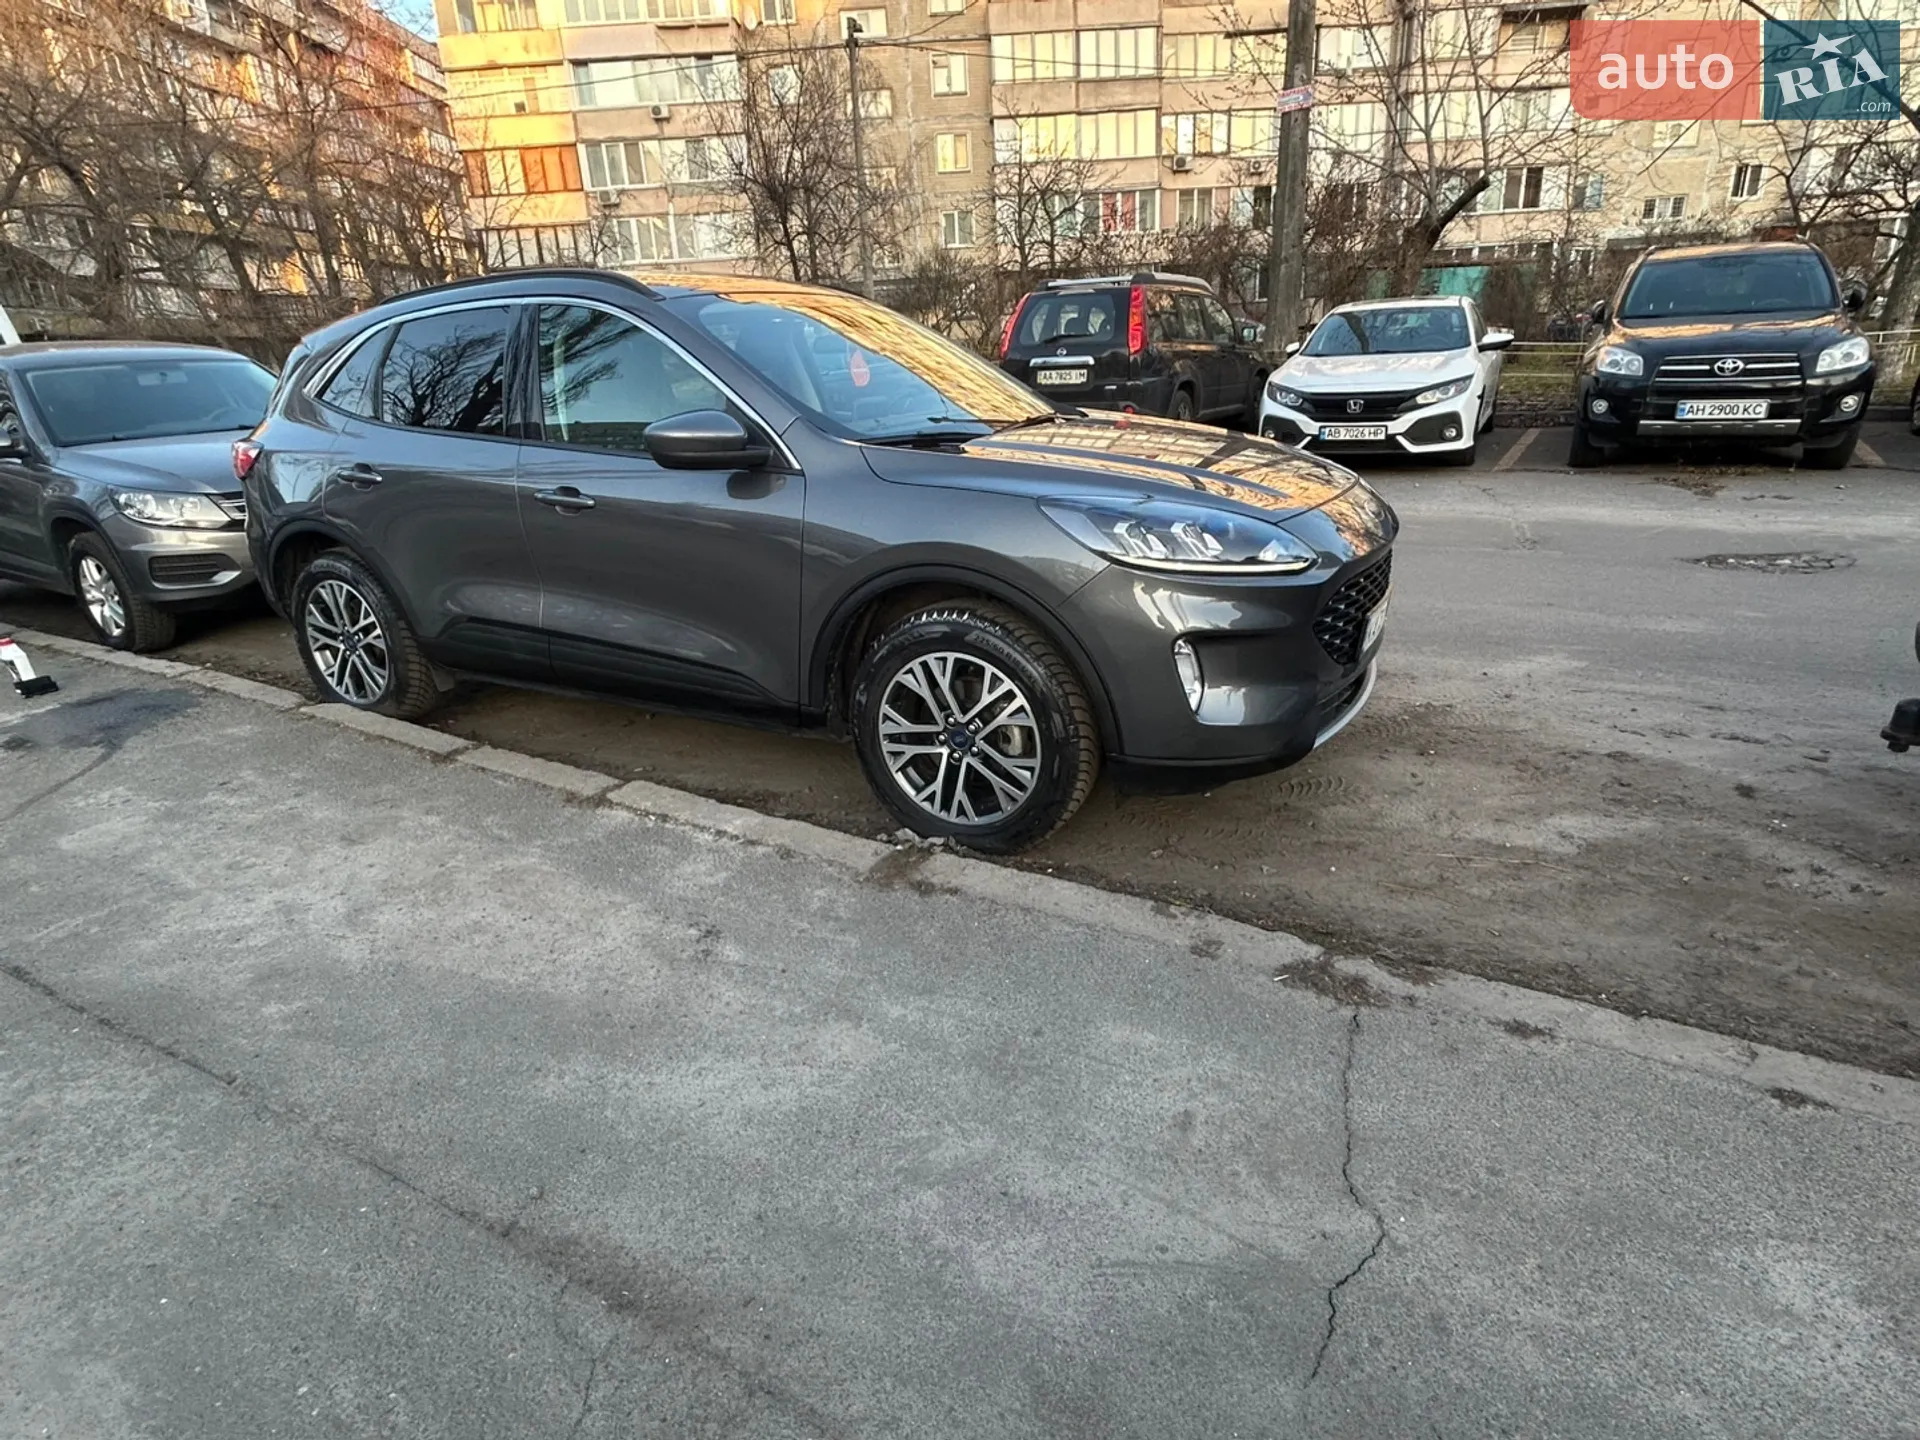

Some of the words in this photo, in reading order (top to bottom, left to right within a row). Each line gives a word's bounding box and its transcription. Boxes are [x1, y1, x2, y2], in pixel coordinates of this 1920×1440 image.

[1685, 404, 1706, 416] AH
[1707, 404, 1740, 416] 2900
[1741, 404, 1763, 416] KC
[1326, 428, 1341, 438] AB
[1368, 428, 1384, 438] HP
